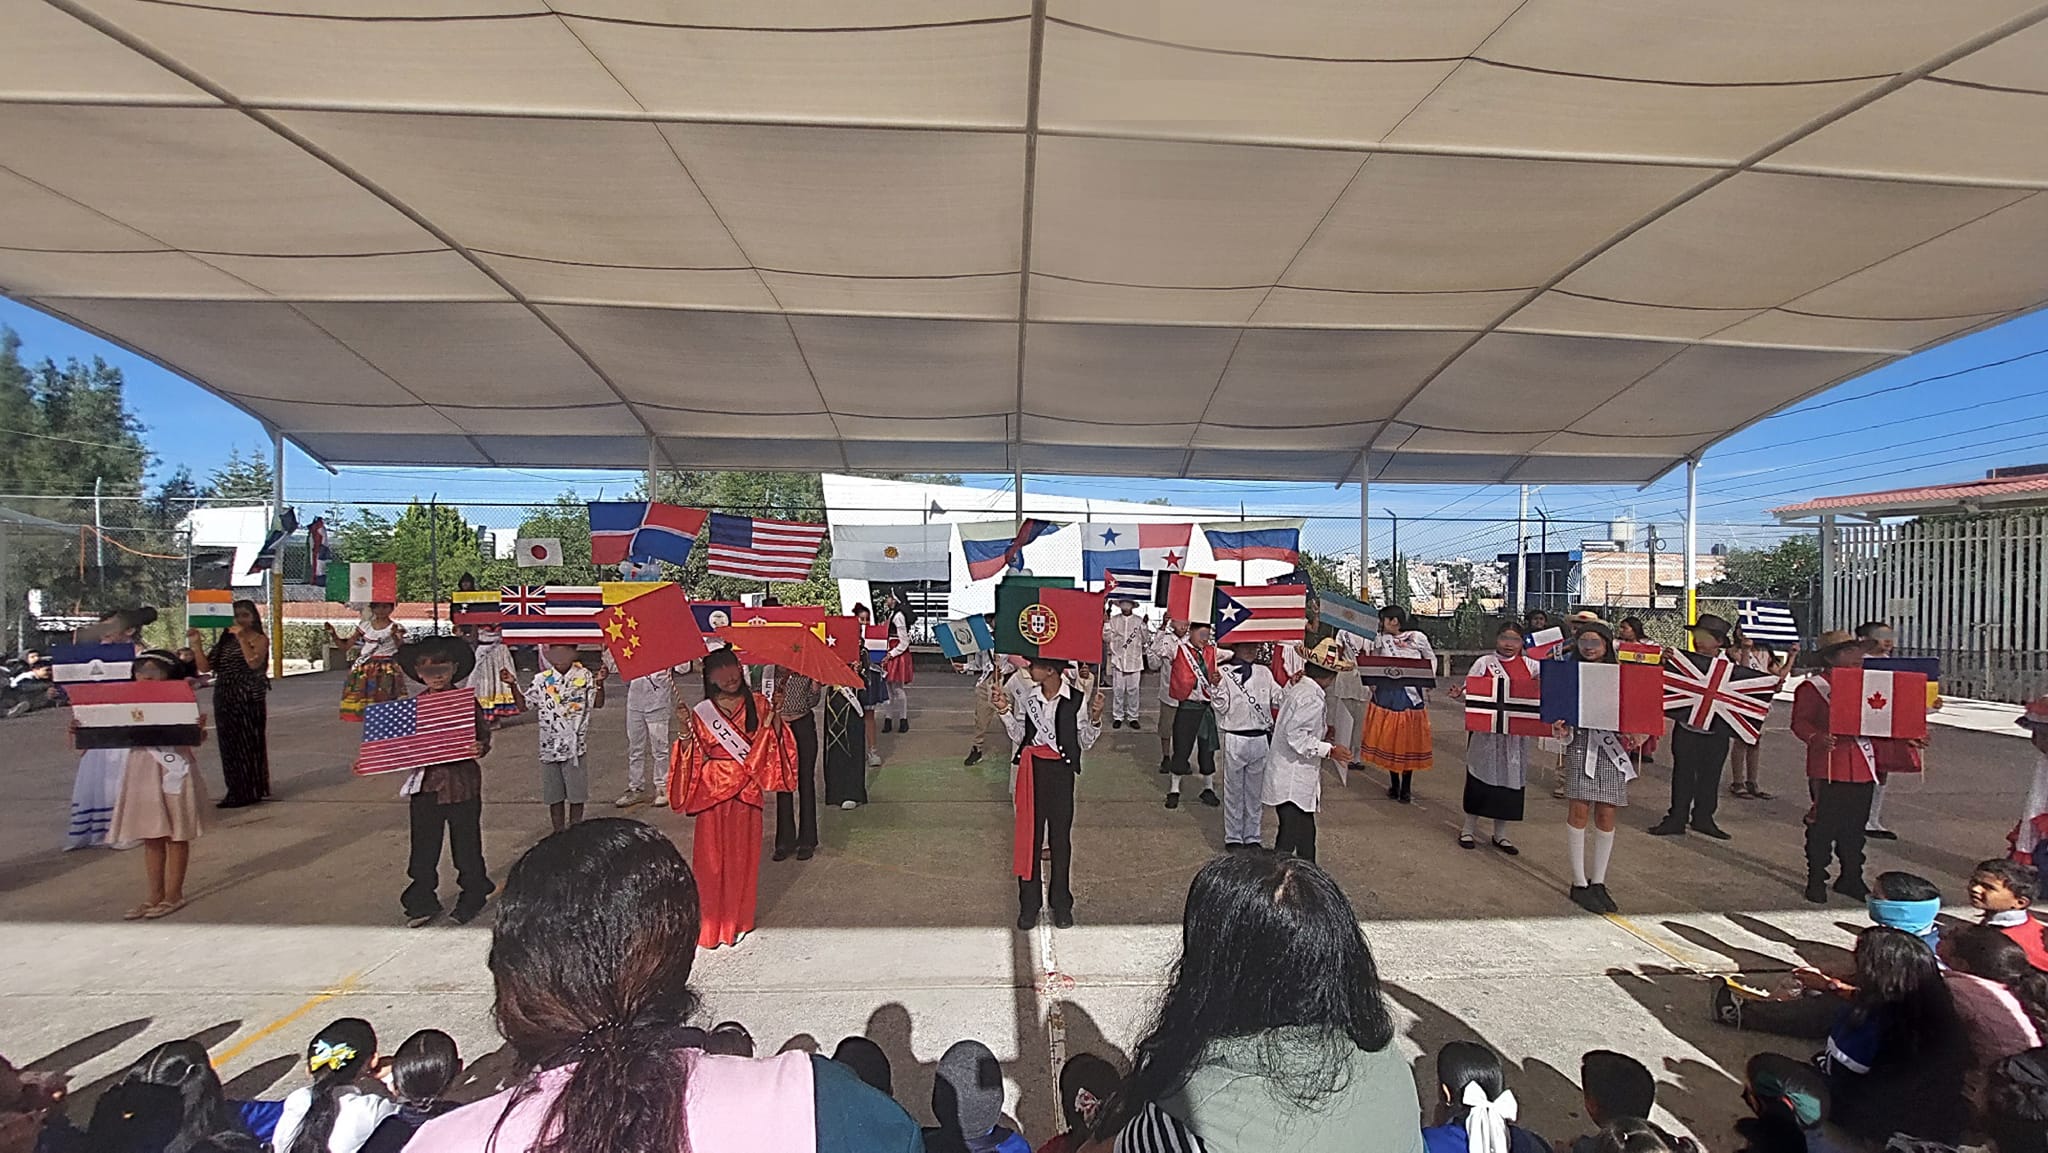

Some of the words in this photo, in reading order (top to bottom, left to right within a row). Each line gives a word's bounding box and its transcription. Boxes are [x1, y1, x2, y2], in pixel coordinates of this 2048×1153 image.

[712, 719, 749, 761] CHIN
[1027, 699, 1056, 740] PORTUG
[1602, 735, 1628, 766] CIA
